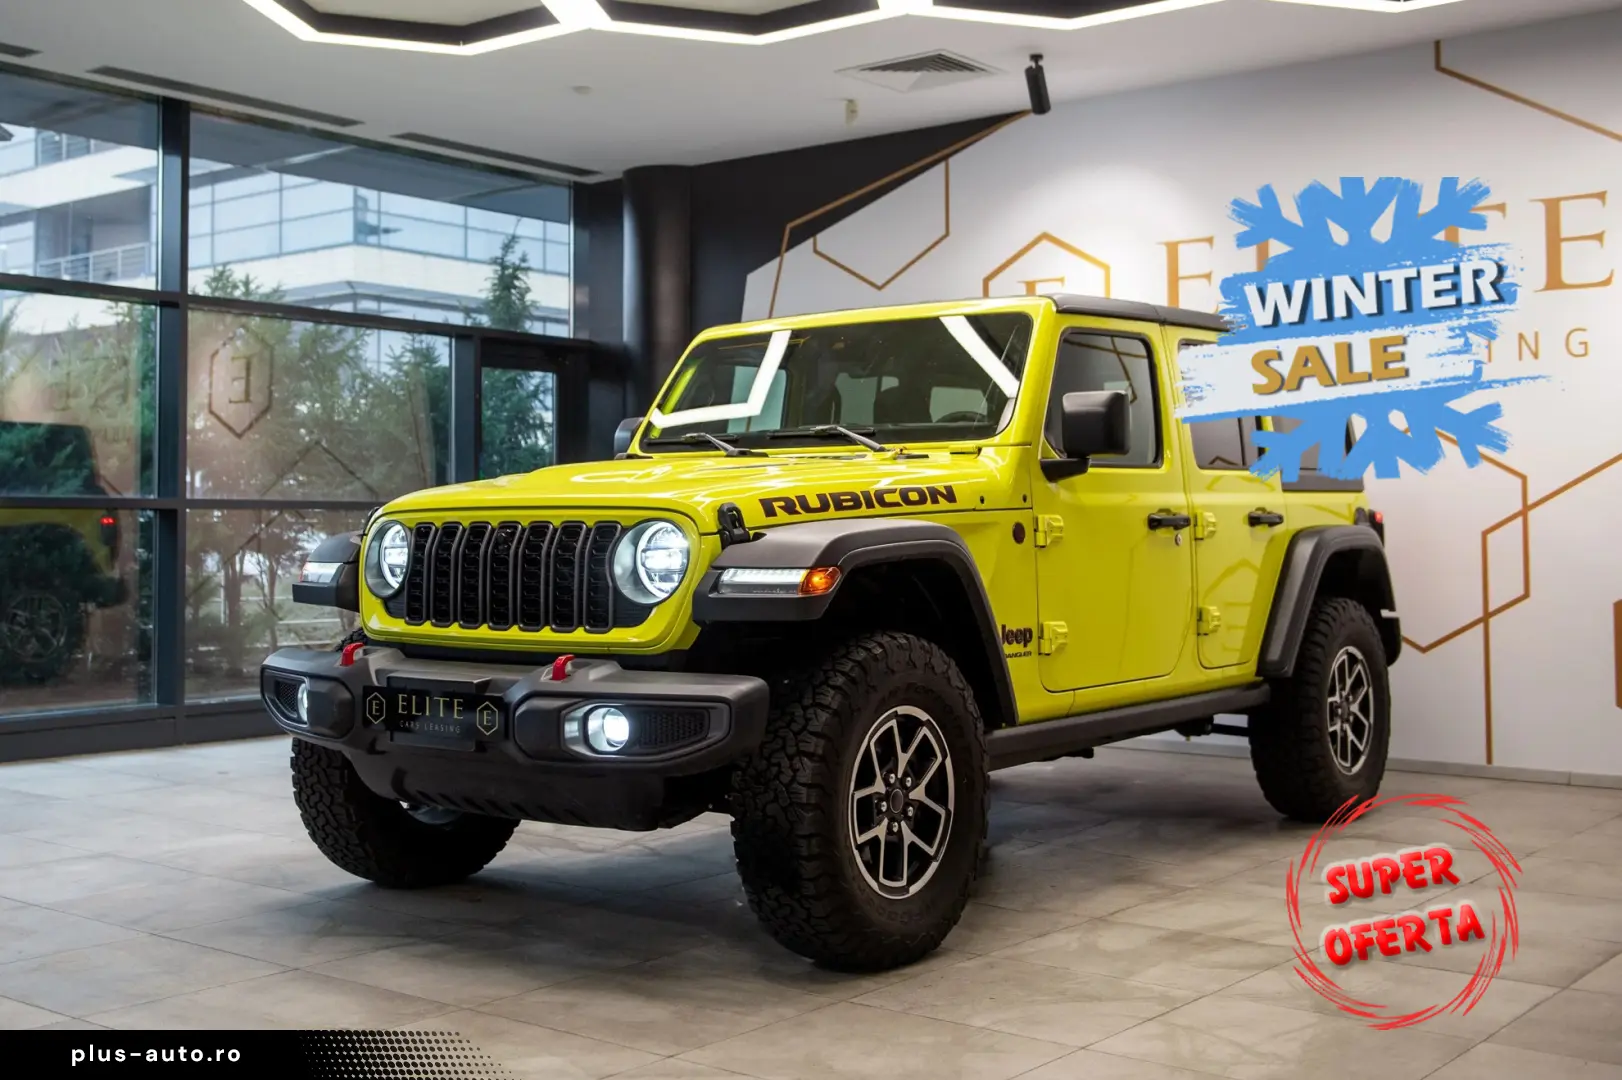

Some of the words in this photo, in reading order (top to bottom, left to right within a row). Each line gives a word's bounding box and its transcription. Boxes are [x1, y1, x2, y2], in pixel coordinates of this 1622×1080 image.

[758, 485, 958, 518] RUBICON
[398, 693, 464, 719] ELITE
[400, 720, 420, 730] CARS
[424, 722, 461, 733] LEASING
